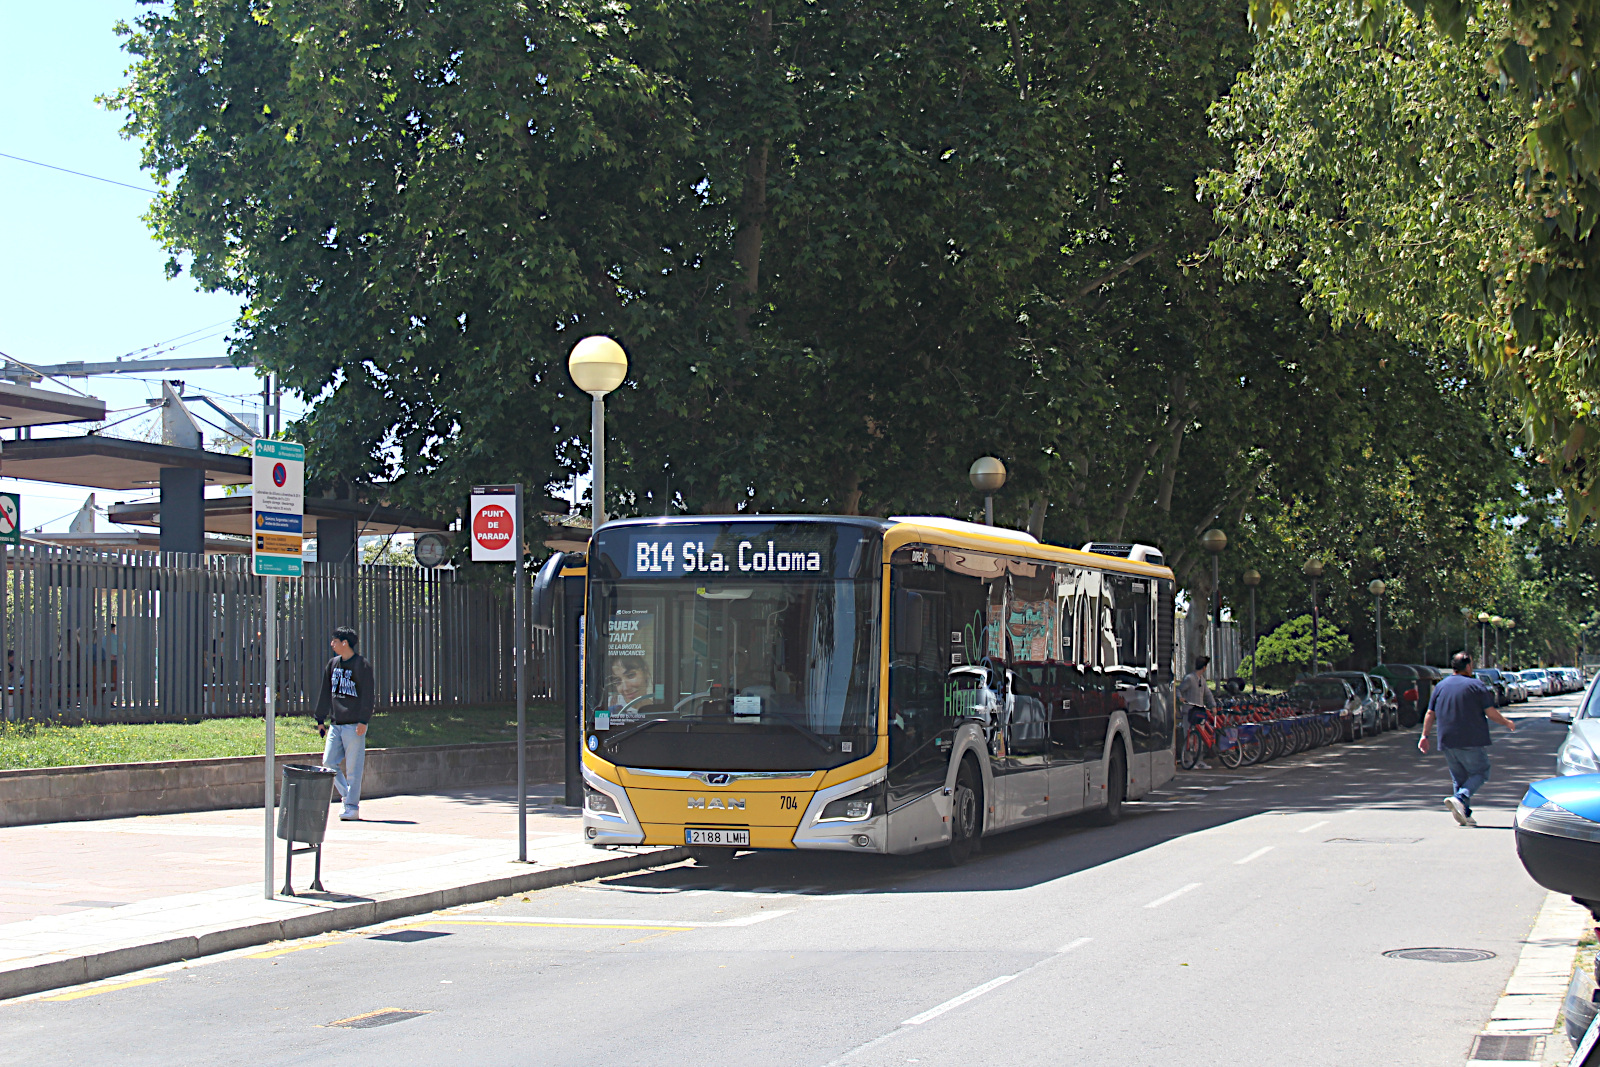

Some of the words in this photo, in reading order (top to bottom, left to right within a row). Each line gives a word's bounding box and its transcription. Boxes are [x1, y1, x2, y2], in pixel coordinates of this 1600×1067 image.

[263, 444, 275, 452] AMB
[636, 542, 675, 572] B14
[682, 542, 730, 572] Sta.
[738, 541, 821, 572] Coloma
[687, 797, 746, 810] MAN
[780, 796, 798, 810] 704
[693, 832, 722, 842] 2188
[726, 833, 746, 844] LMH
